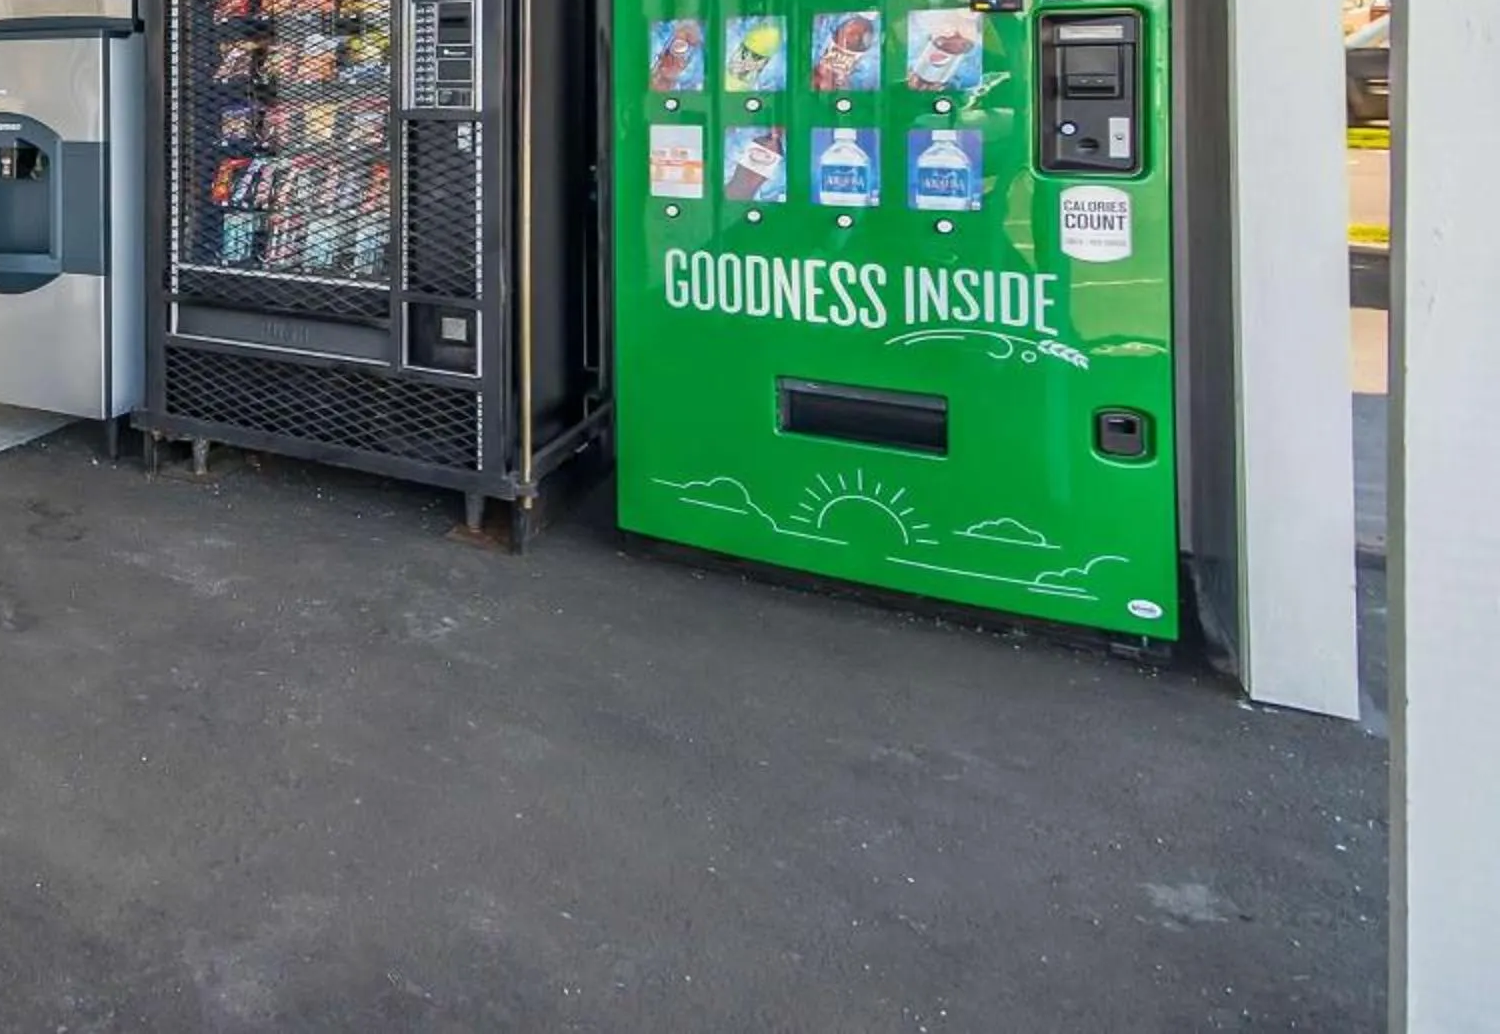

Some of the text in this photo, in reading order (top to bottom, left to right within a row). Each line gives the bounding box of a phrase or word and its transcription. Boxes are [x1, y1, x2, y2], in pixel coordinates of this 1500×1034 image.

[1063, 199, 1127, 213] CALORIES
[1064, 213, 1126, 231] COUNT
[664, 248, 1059, 336] GOODNESS INSIDE
